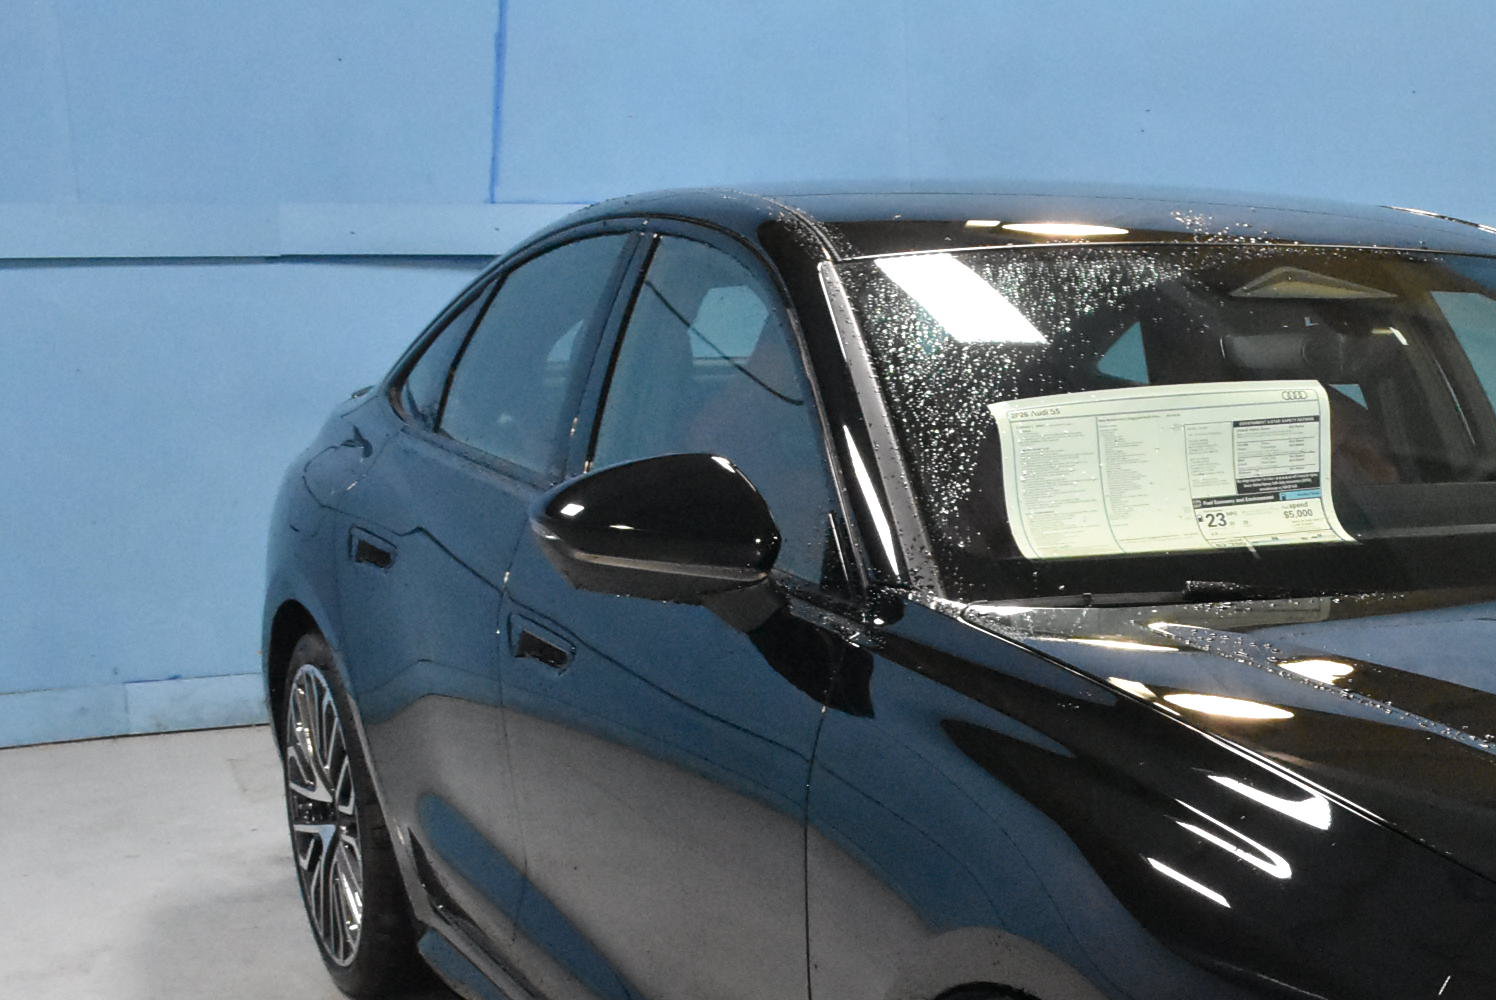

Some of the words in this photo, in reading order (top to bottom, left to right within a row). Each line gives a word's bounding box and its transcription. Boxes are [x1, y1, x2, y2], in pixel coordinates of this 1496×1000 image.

[1031, 409, 1049, 417] Audi
[1289, 502, 1308, 510] spend
[1283, 509, 1313, 519] $5,000
[1205, 512, 1227, 528] 23
